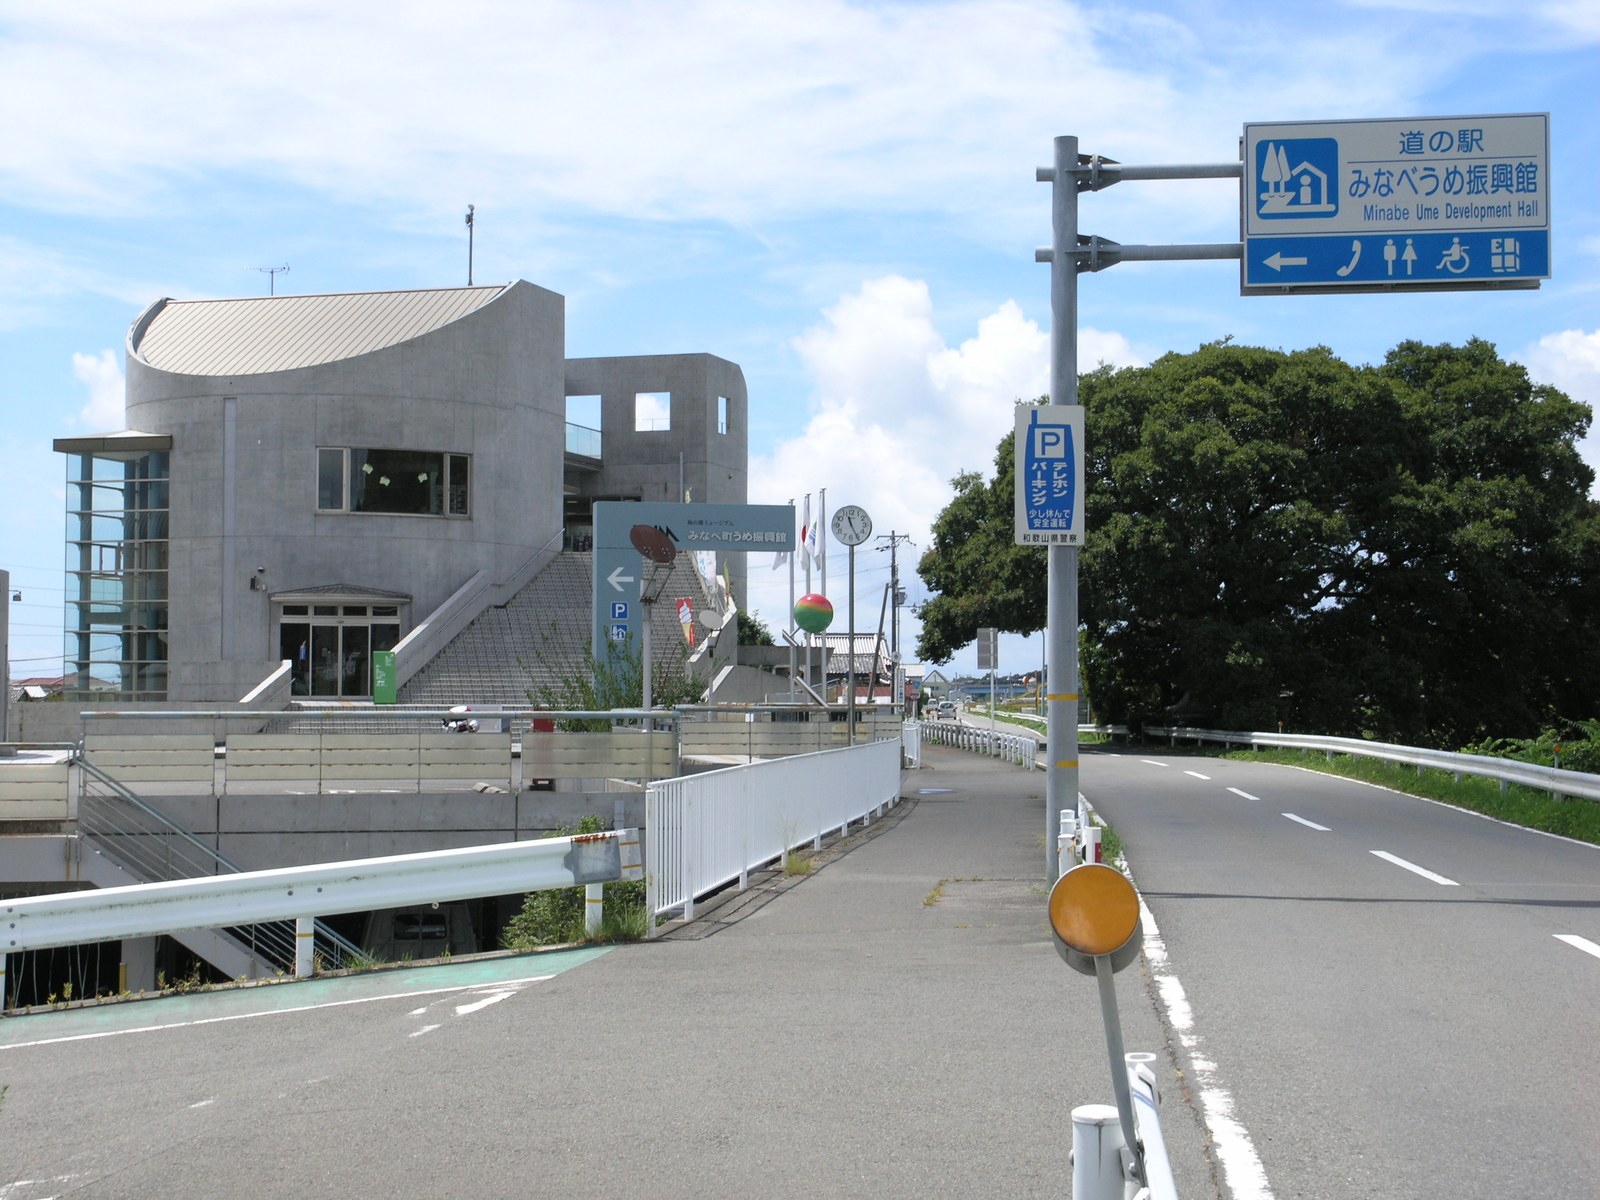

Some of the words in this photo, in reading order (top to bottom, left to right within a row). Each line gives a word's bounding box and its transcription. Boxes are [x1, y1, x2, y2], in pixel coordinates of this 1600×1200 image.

[1399, 129, 1485, 155] 道の駅
[1348, 161, 1538, 198] みなべうめ振興館
[1363, 204, 1409, 221] Minabe
[1416, 203, 1439, 220] Ume
[1445, 201, 1512, 223] Development
[1518, 200, 1538, 217] Hall
[1041, 432, 1061, 456] P
[1031, 461, 1047, 506] パーキング
[1052, 462, 1068, 498] テレホン
[1029, 508, 1071, 519] 少し休んで
[1033, 518, 1067, 528] 安全運転
[687, 531, 787, 543] みなべ町うめ振興館
[1023, 533, 1077, 543] 和歌山県警察
[615, 604, 625, 618] P
